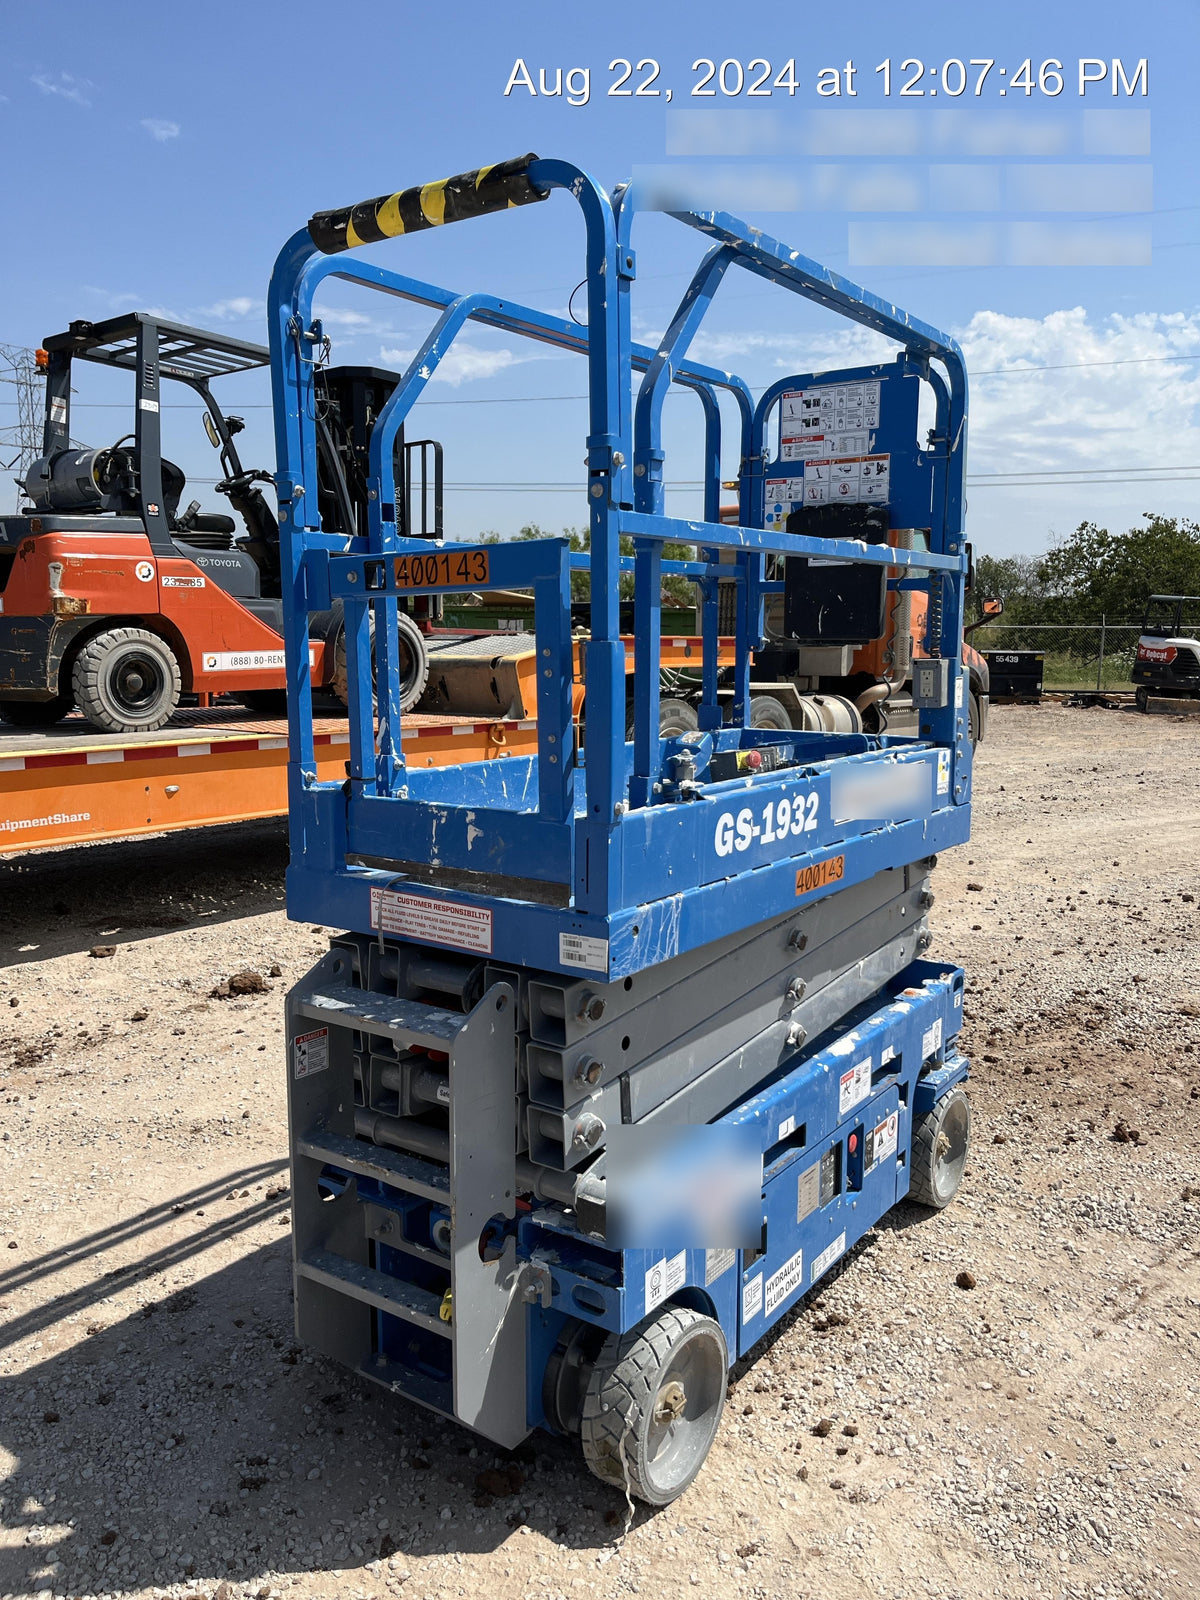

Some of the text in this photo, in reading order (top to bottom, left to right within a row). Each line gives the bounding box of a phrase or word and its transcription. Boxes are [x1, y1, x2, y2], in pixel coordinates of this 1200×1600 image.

[209, 558, 242, 568] TOYOTA
[396, 551, 487, 586] 400143
[164, 577, 203, 587] 2385
[230, 656, 252, 666] (888)
[0, 812, 91, 832] uipmentShare
[714, 791, 819, 857] GS-1932
[796, 856, 844, 893] 400143
[397, 896, 489, 920] CUSTOMER RESPONSIBILITY
[766, 1255, 801, 1296] HYDRAULIC
[766, 1287, 784, 1312] FLUID
[786, 1270, 801, 1293] ONLY
